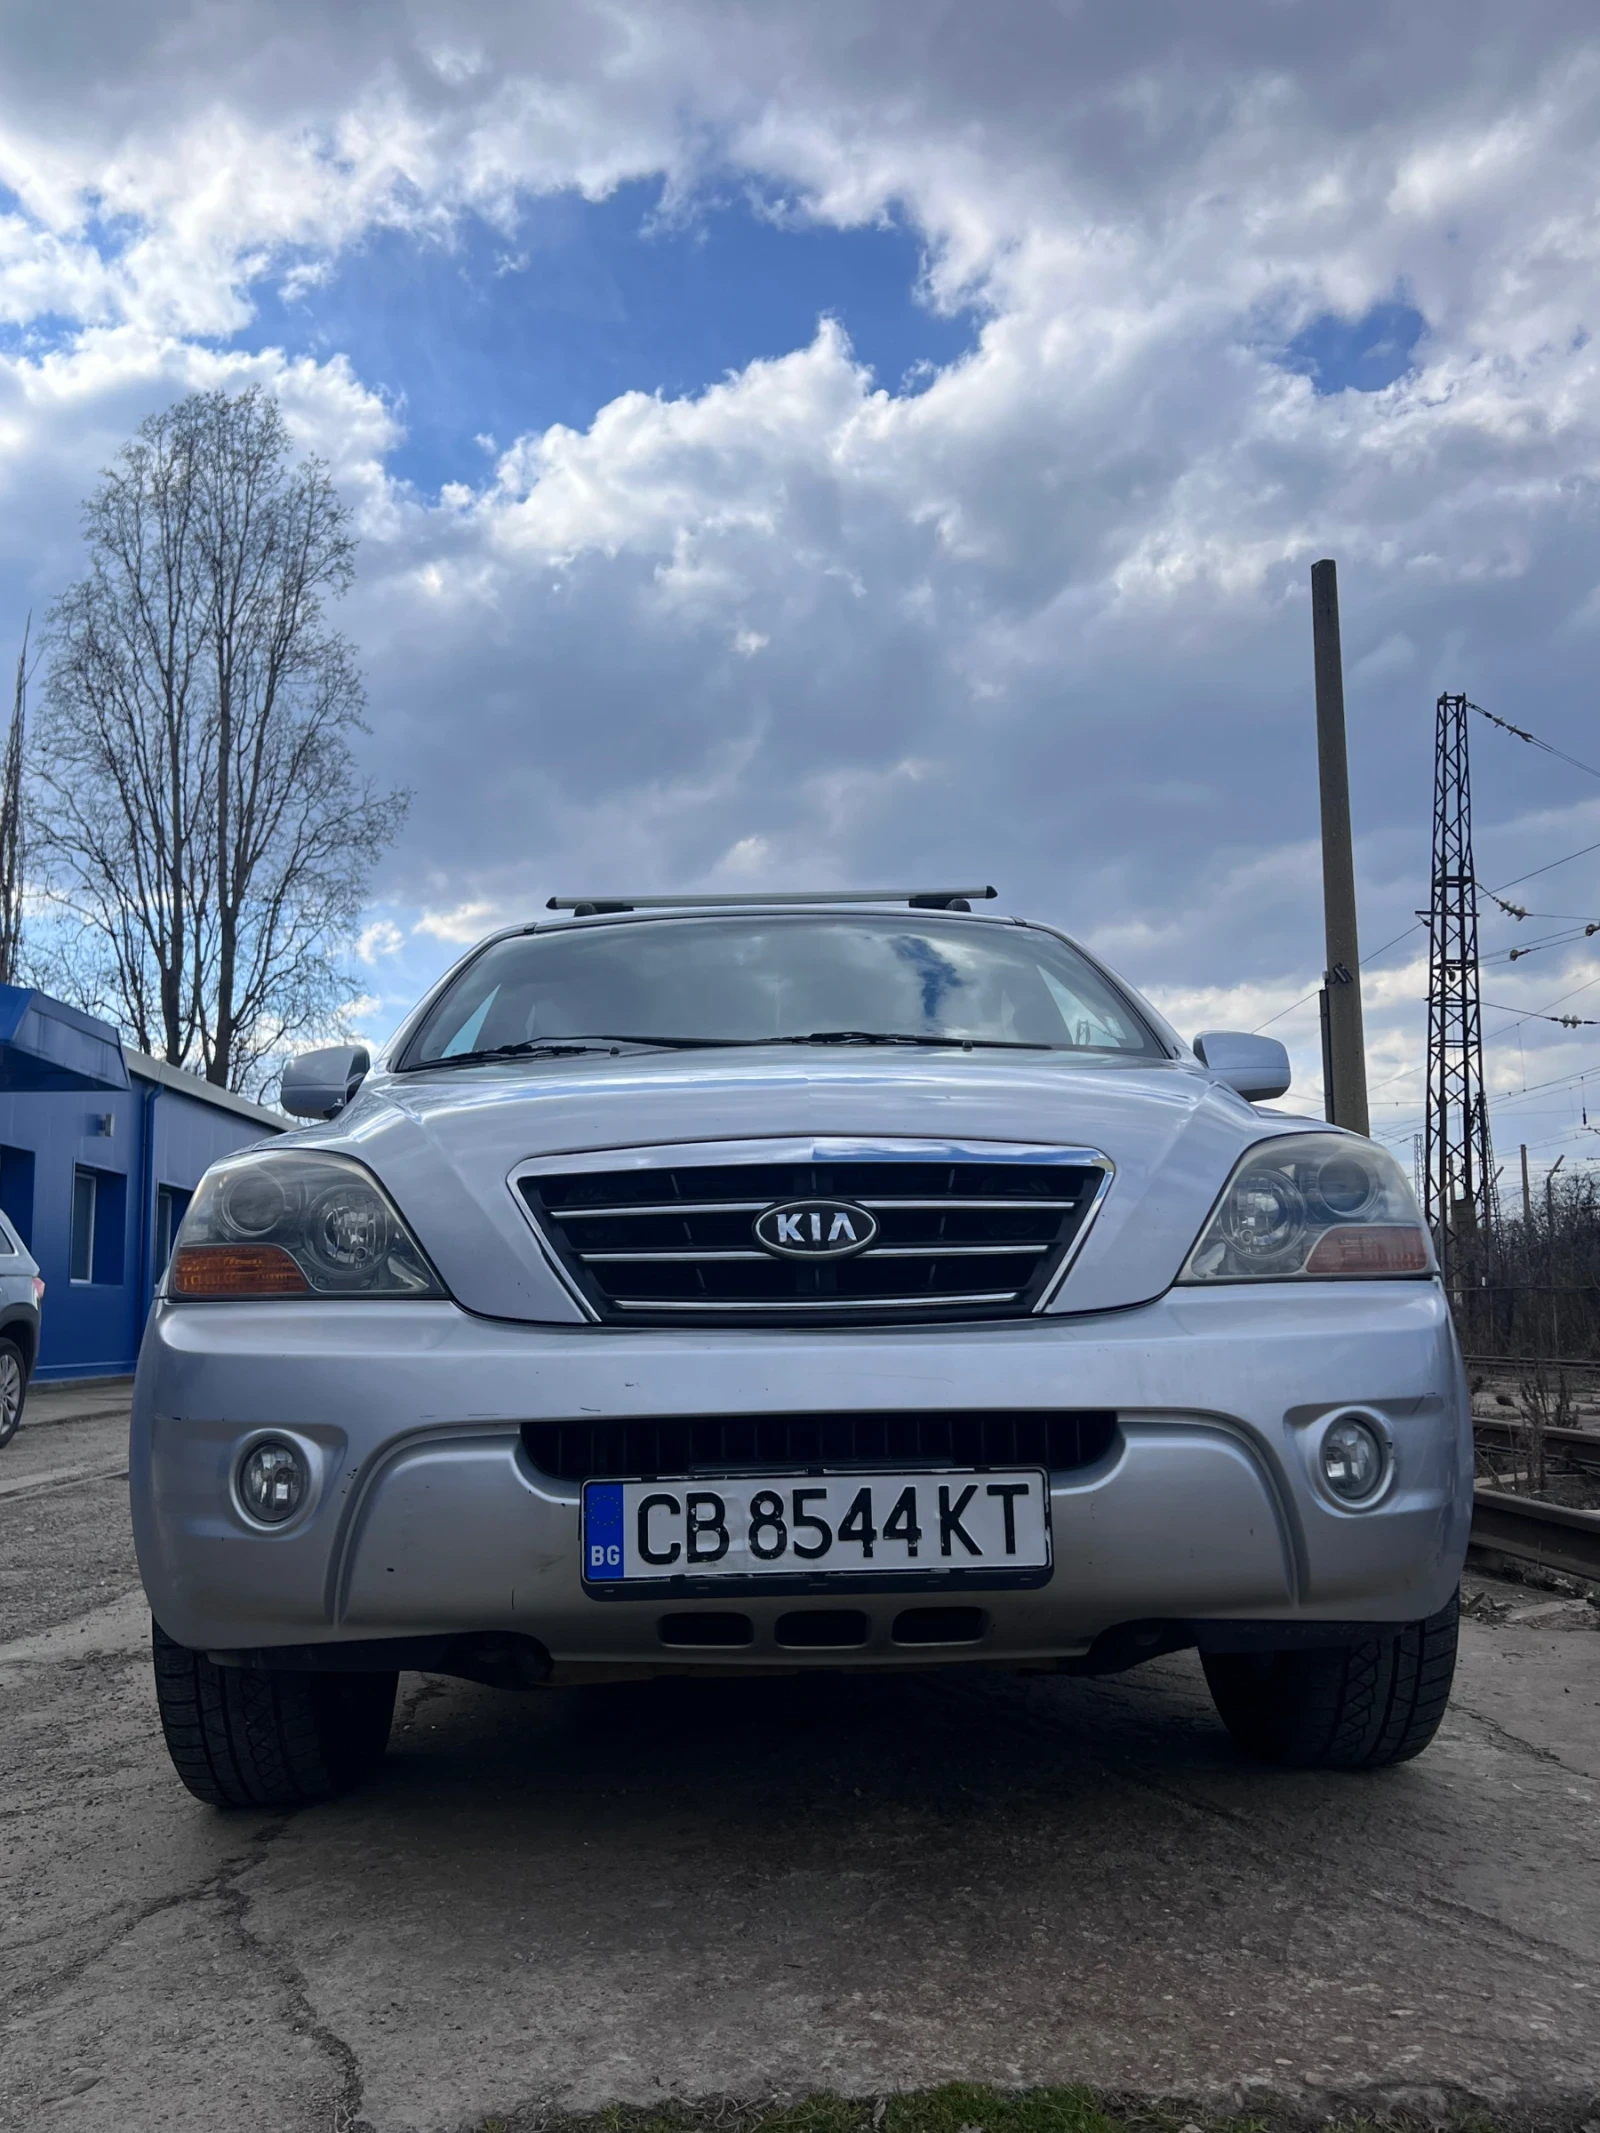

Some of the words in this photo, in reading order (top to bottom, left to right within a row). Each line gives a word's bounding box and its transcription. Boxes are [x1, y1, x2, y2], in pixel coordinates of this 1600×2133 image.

[776, 1213, 857, 1242] KIA
[637, 1492, 730, 1564] CB
[748, 1486, 922, 1559] 8544
[938, 1483, 1029, 1556] KT
[591, 1545, 620, 1567] BG
